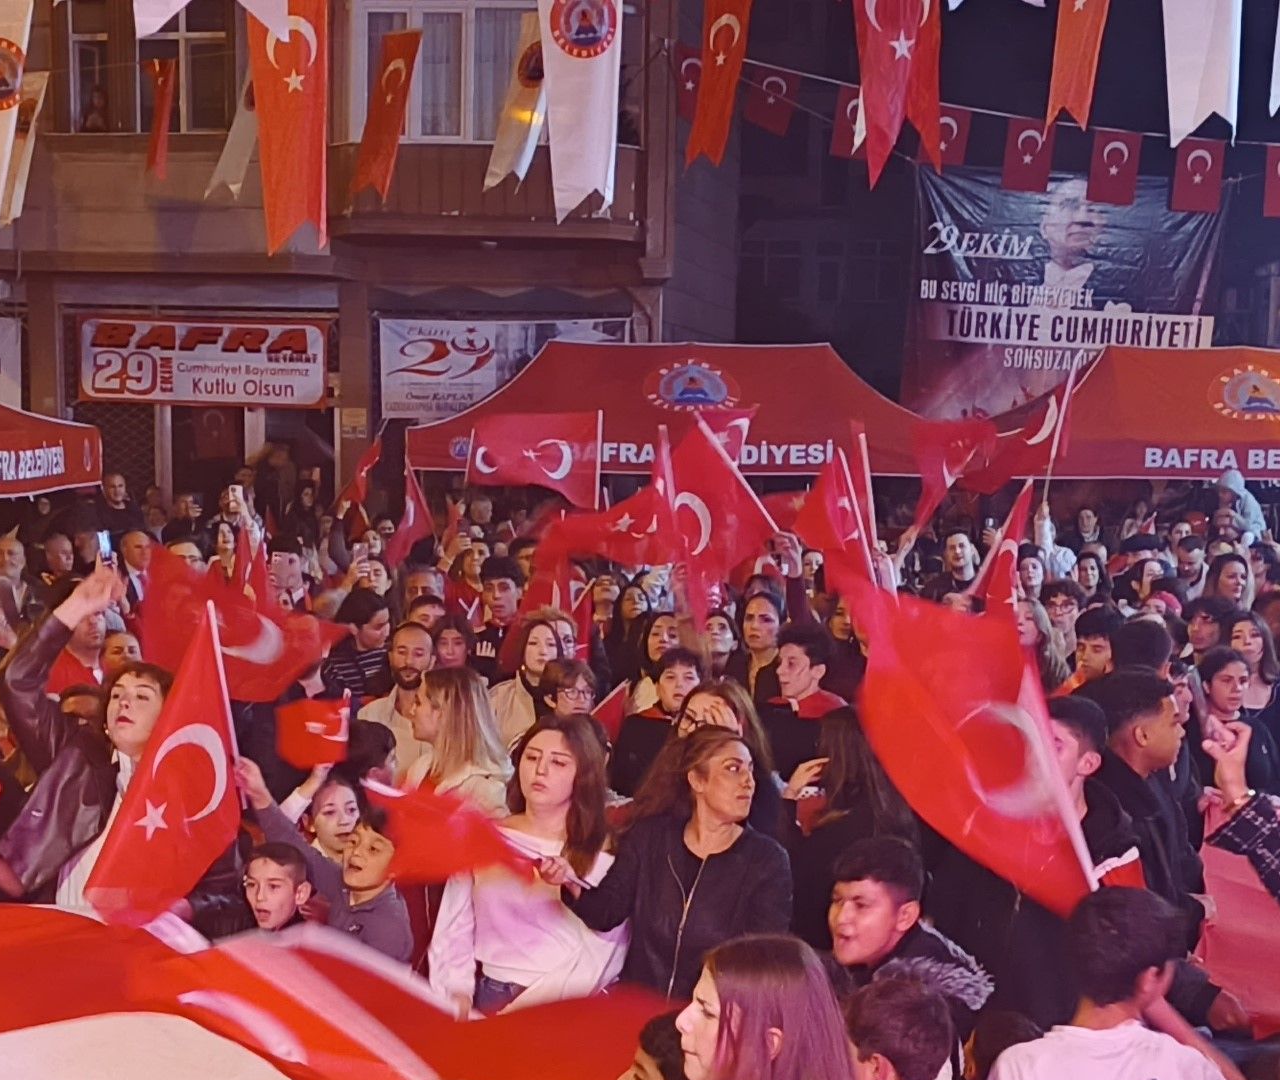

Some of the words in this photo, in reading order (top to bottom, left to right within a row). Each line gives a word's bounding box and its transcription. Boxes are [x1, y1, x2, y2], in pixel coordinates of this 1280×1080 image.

[923, 221, 959, 255] 29
[959, 227, 1035, 258] EKİM
[920, 279, 937, 299] BU
[941, 279, 981, 303] SEVGİ
[984, 281, 1008, 306] HİÇ
[91, 321, 309, 354] BAFRA
[946, 306, 1041, 341] TÜRKİYE
[1050, 315, 1203, 348] CUMHURİYETİ
[93, 350, 158, 395] 29
[177, 362, 242, 376] Cumhuriyet
[245, 364, 310, 378] Bayramımız
[1004, 347, 1072, 371] SONSUZA
[192, 377, 236, 395] Kutlu
[243, 379, 295, 398] Olsun
[1144, 447, 1239, 470] BAFRA
